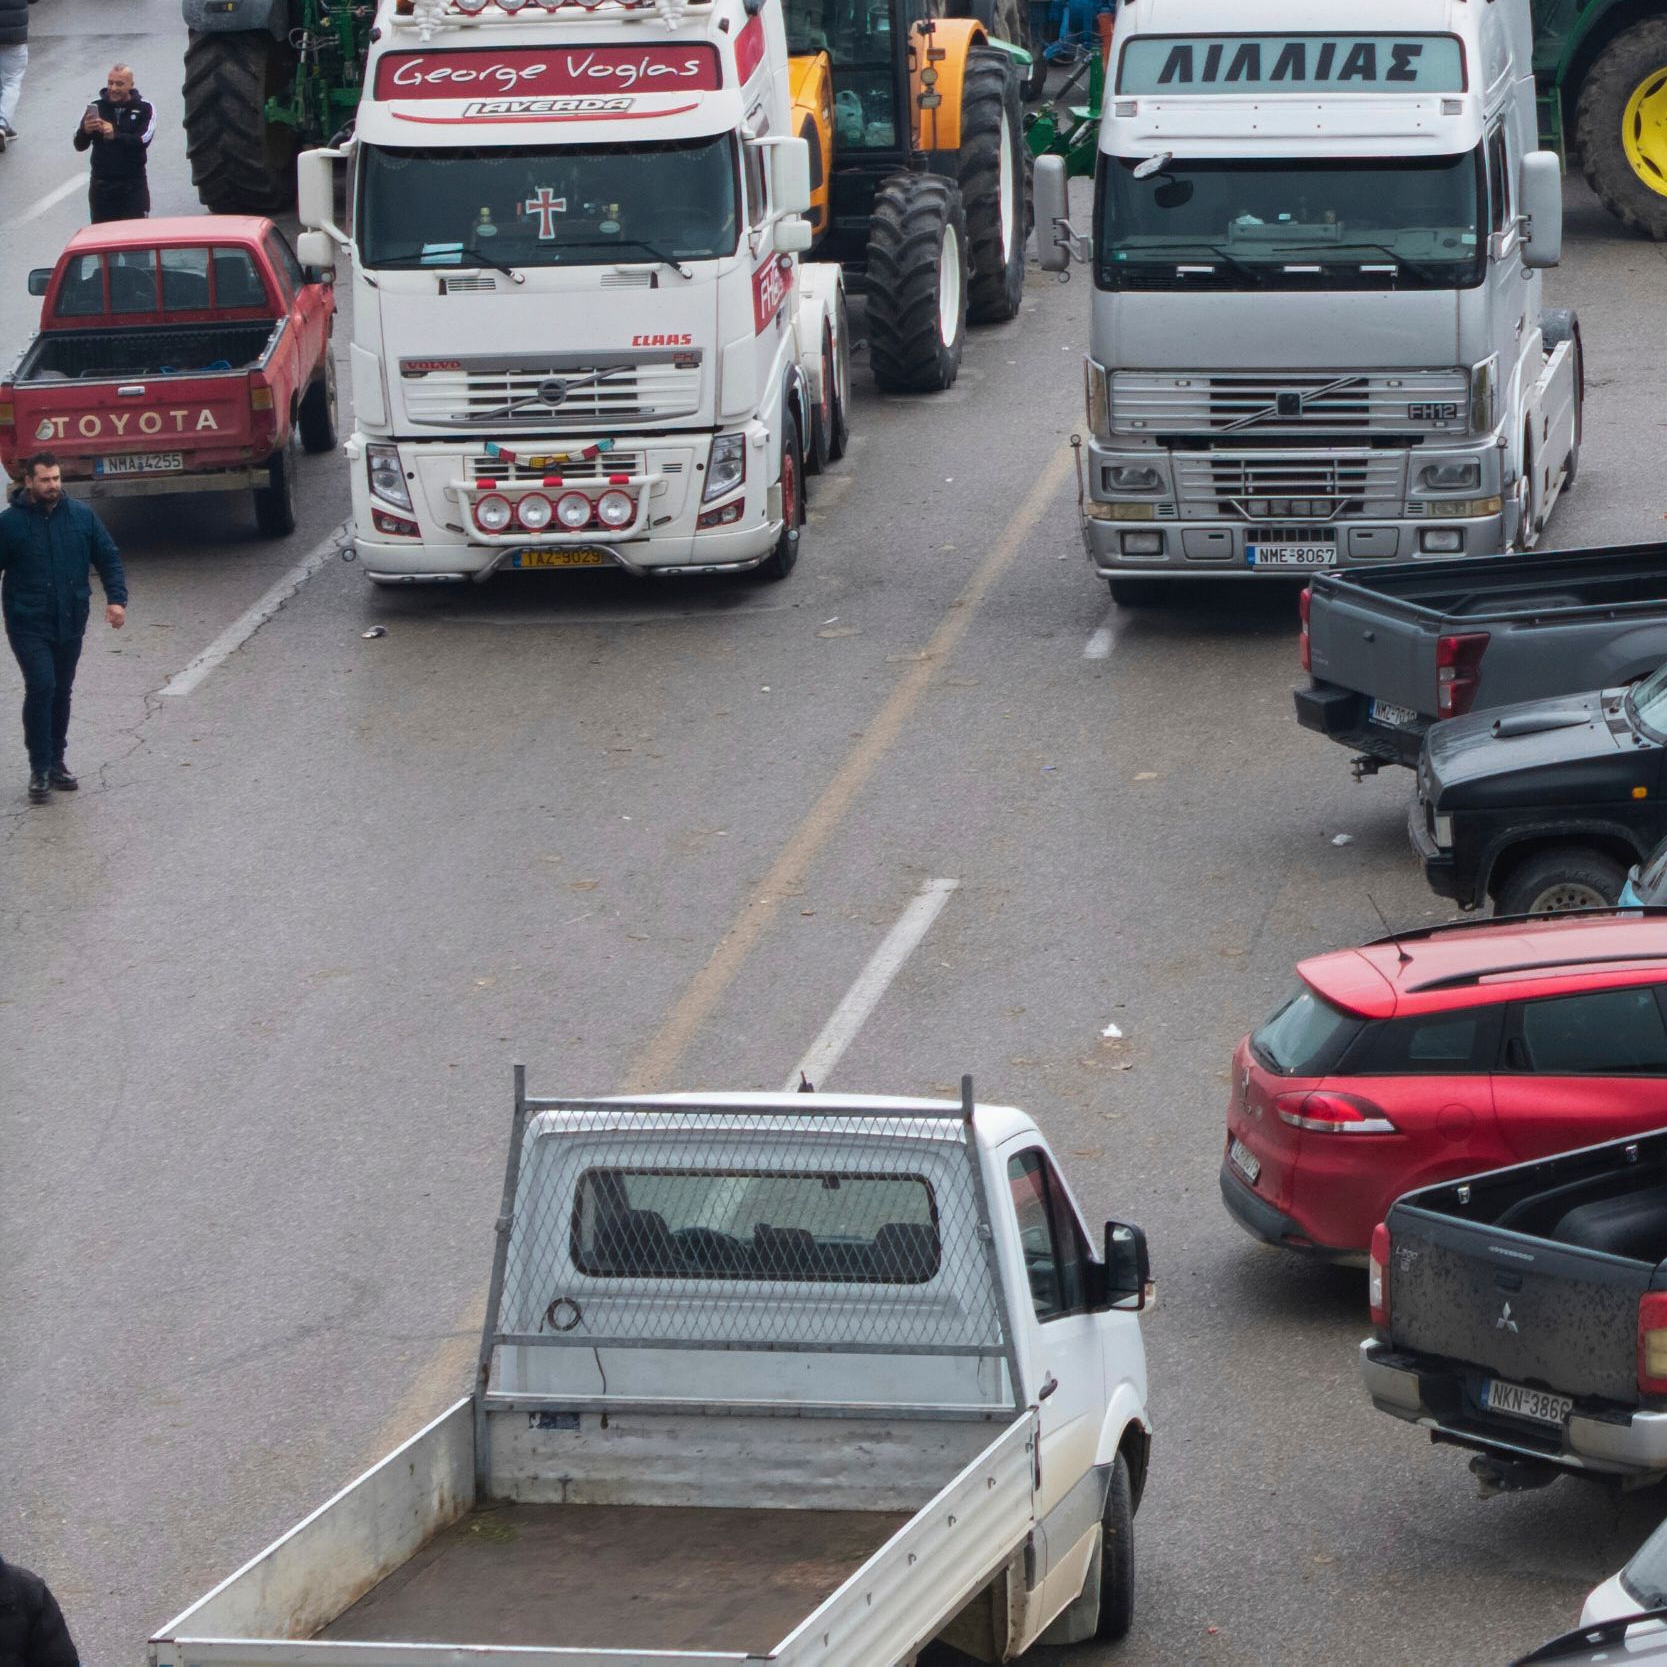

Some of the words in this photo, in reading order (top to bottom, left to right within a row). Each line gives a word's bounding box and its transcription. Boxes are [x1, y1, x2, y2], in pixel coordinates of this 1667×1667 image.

[1158, 41, 1424, 83] ΛΙΛΛΙΑΣ
[393, 59, 547, 93] George
[567, 52, 701, 89] Voglas
[464, 99, 634, 118] LAVERDA
[632, 334, 693, 347] CLAAS
[406, 360, 461, 371] VOLVO
[1409, 404, 1456, 419] FH12
[54, 408, 219, 438] TOYOTA
[1259, 547, 1336, 565] NME-8067
